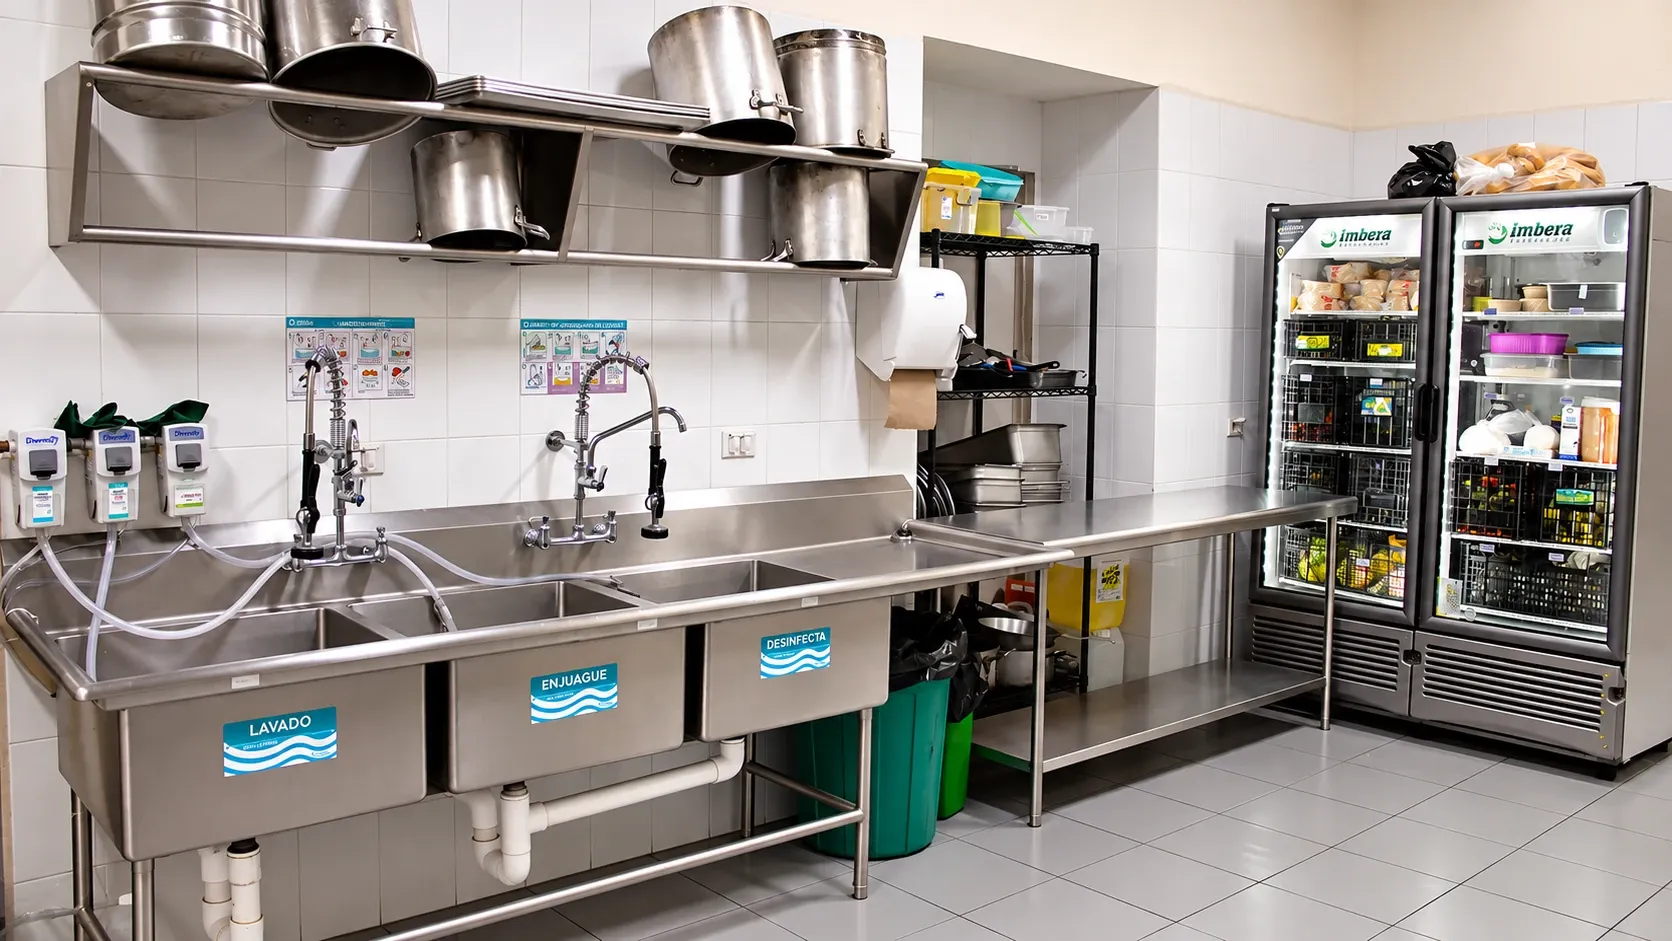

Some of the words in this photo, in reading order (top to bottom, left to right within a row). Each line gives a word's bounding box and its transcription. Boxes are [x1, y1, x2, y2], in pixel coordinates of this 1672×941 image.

[1339, 228, 1392, 242] imbera
[1509, 222, 1574, 238] imbera
[767, 631, 827, 650] DESINFECTA
[542, 669, 607, 691] ENJUAGUE
[249, 715, 312, 737] LAVADO
